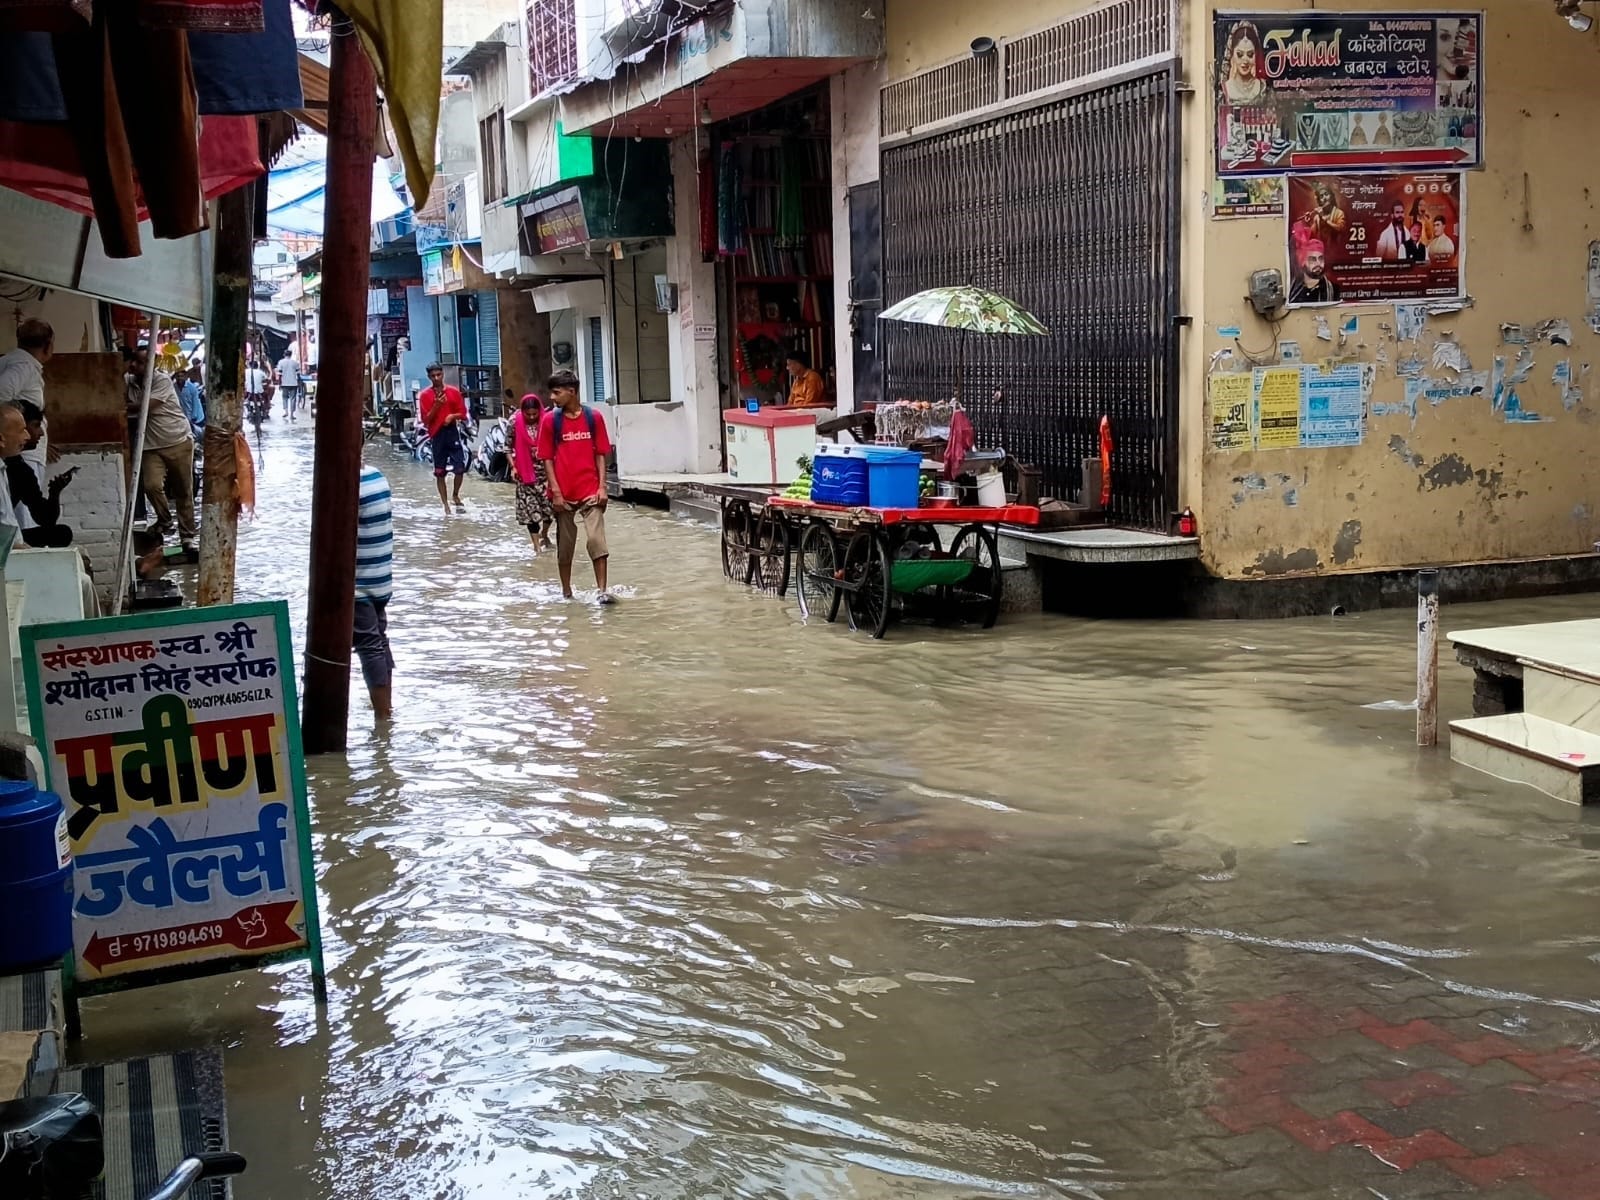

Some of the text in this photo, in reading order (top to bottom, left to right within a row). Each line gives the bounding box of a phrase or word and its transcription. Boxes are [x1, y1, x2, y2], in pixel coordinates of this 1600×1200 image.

[1263, 28, 1342, 78] Fahad
[1347, 33, 1427, 54] कॉस्मेटिक्स
[1344, 55, 1431, 75] जनरल स्टोर
[1349, 227, 1366, 241] 28
[562, 431, 591, 441] adidas
[215, 622, 257, 652] श्री
[45, 653, 277, 705] श्यौदान सिंह सर्राफ
[54, 693, 279, 841] प्रवीण
[133, 924, 223, 952] 9719894619
